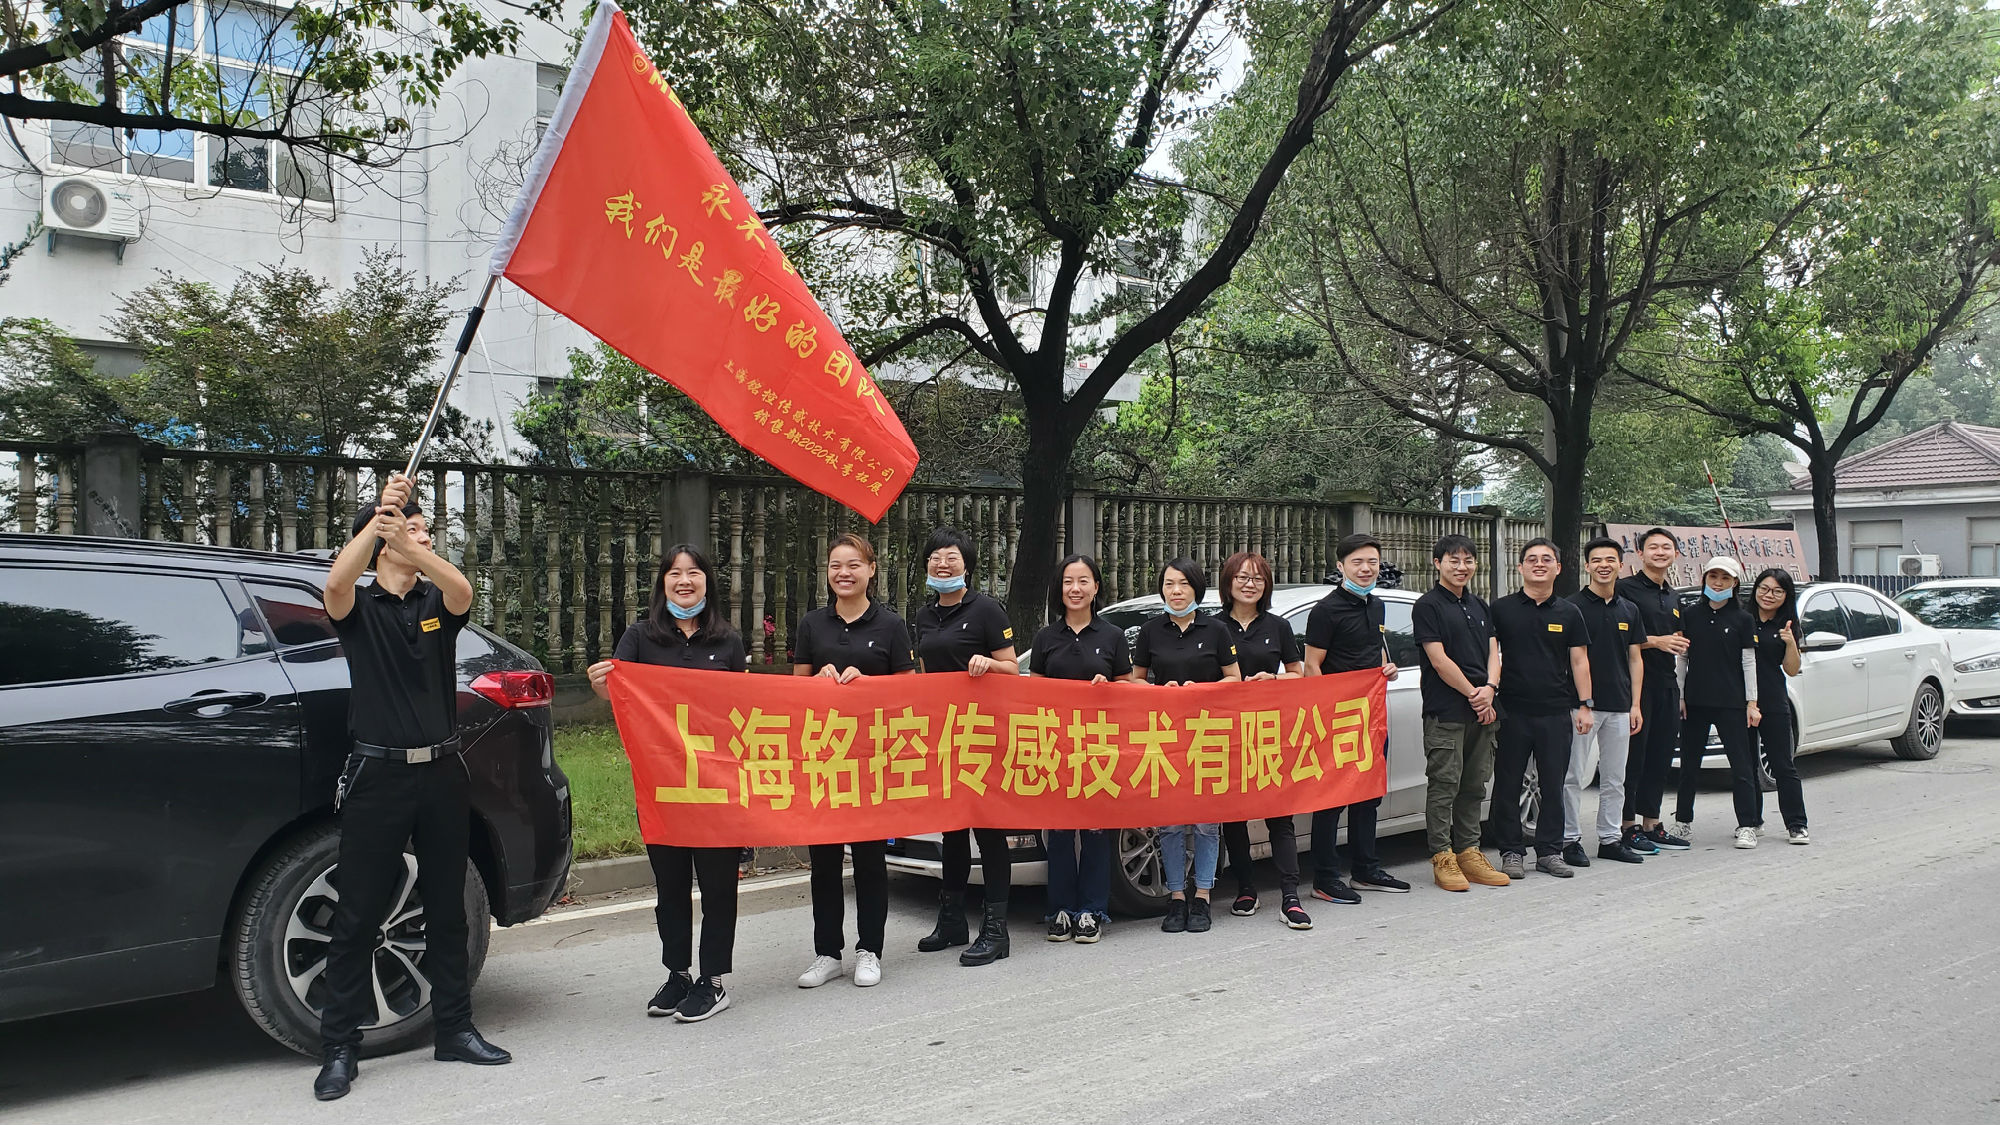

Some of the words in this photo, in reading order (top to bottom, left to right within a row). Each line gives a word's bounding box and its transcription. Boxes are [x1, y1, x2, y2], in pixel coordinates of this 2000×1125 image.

[604, 190, 886, 416] 我们是最好的团队
[723, 359, 895, 482] 上海铭控传感技术有限公司
[752, 408, 883, 497] 销售部2020秋季拓展
[654, 695, 1374, 811] 上海铭控传感技术有限公司
